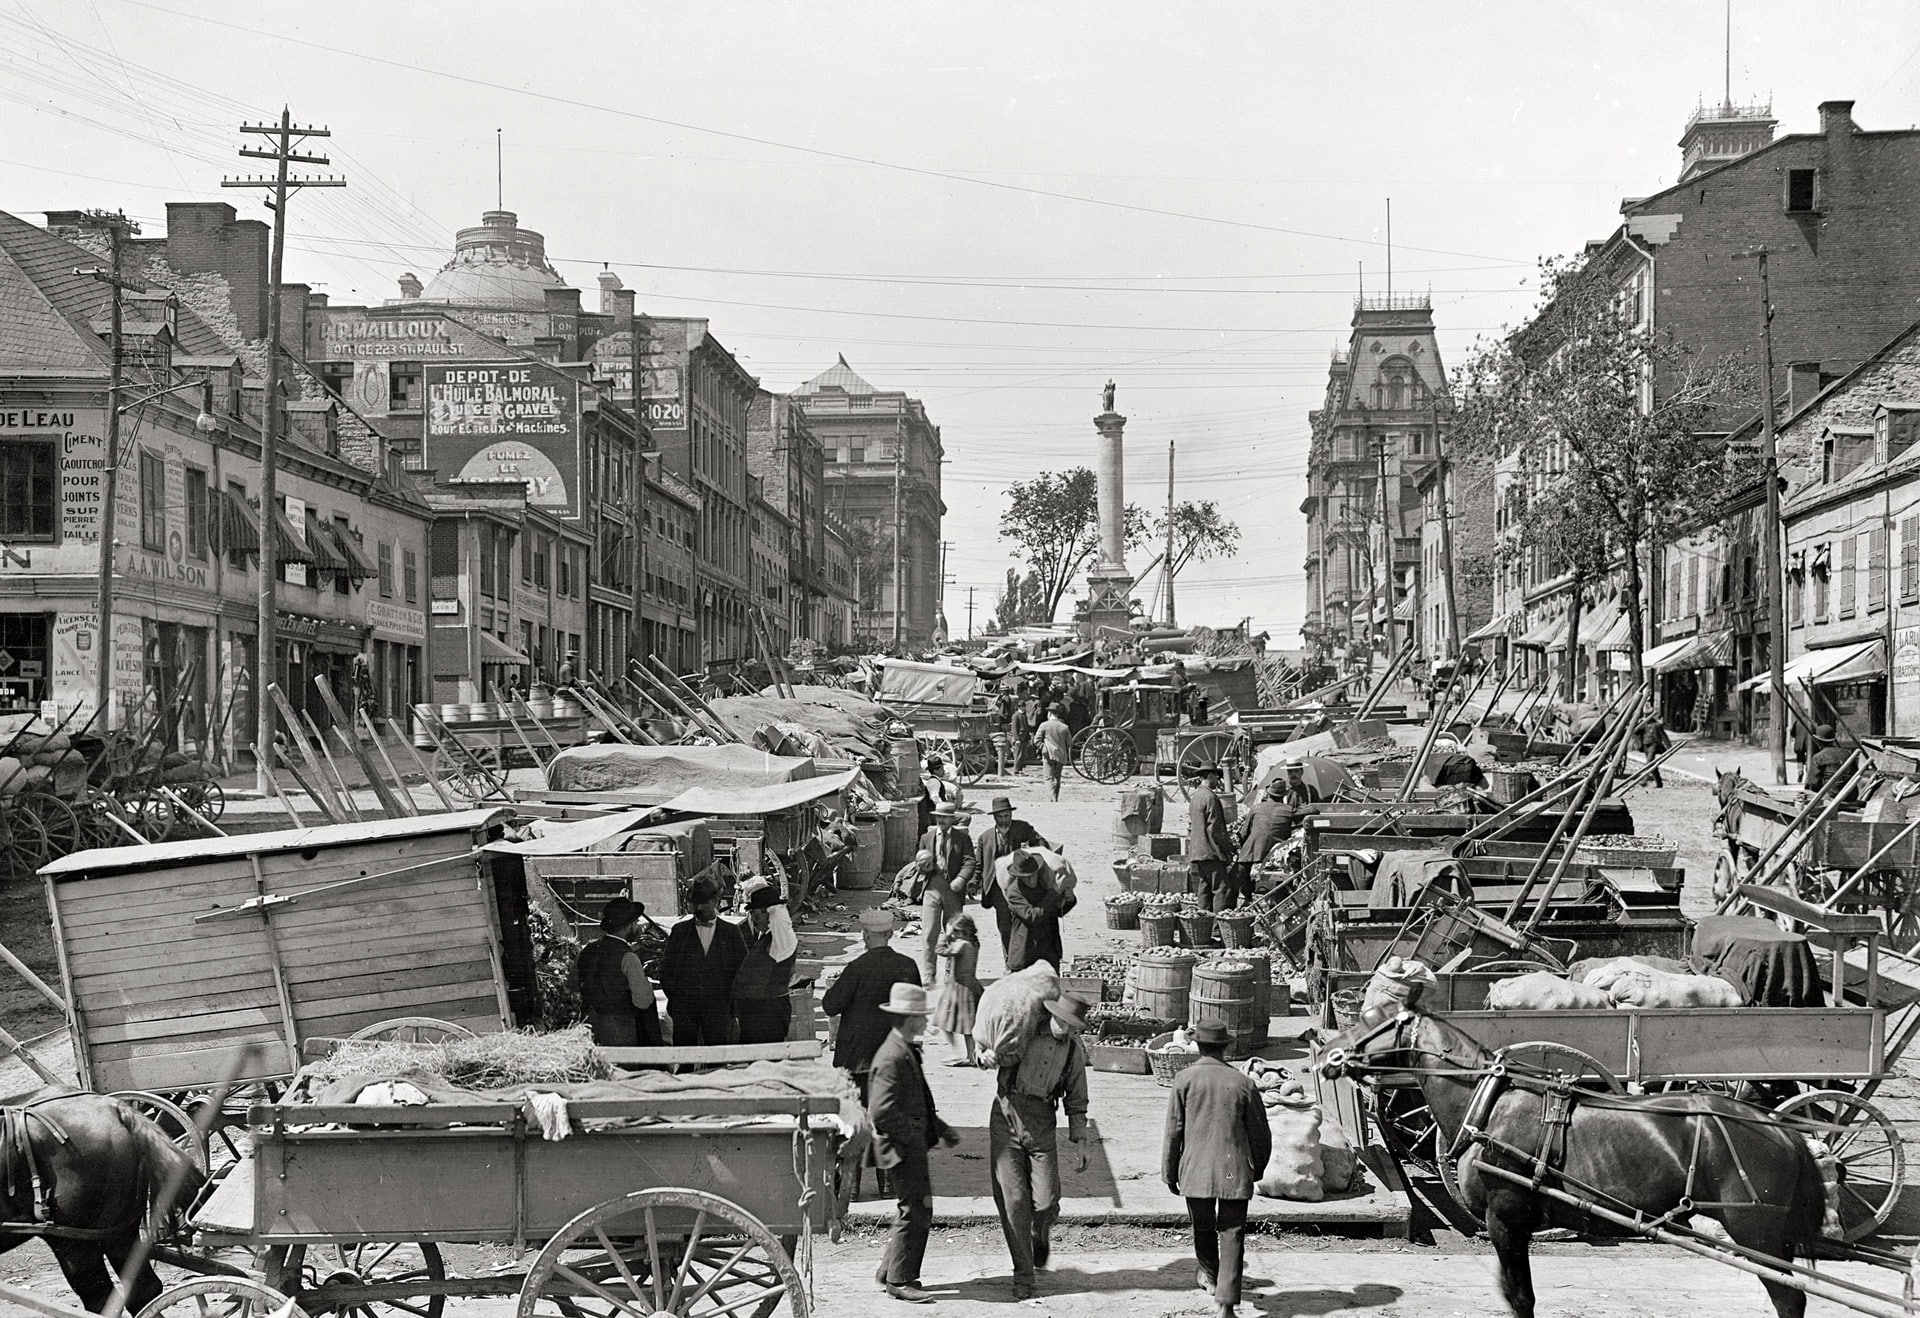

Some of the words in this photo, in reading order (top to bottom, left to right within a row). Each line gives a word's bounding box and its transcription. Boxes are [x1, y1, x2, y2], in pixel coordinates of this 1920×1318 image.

[352, 320, 449, 340] MAILLOUX
[374, 344, 396, 355] 223
[64, 432, 103, 454] CIMENT
[488, 452, 531, 461] FUMEZ
[500, 463, 517, 474] LE
[63, 477, 99, 486] POUR
[62, 492, 100, 502] JOINTS
[66, 507, 98, 515] SUR
[63, 531, 99, 539] TAILLE
